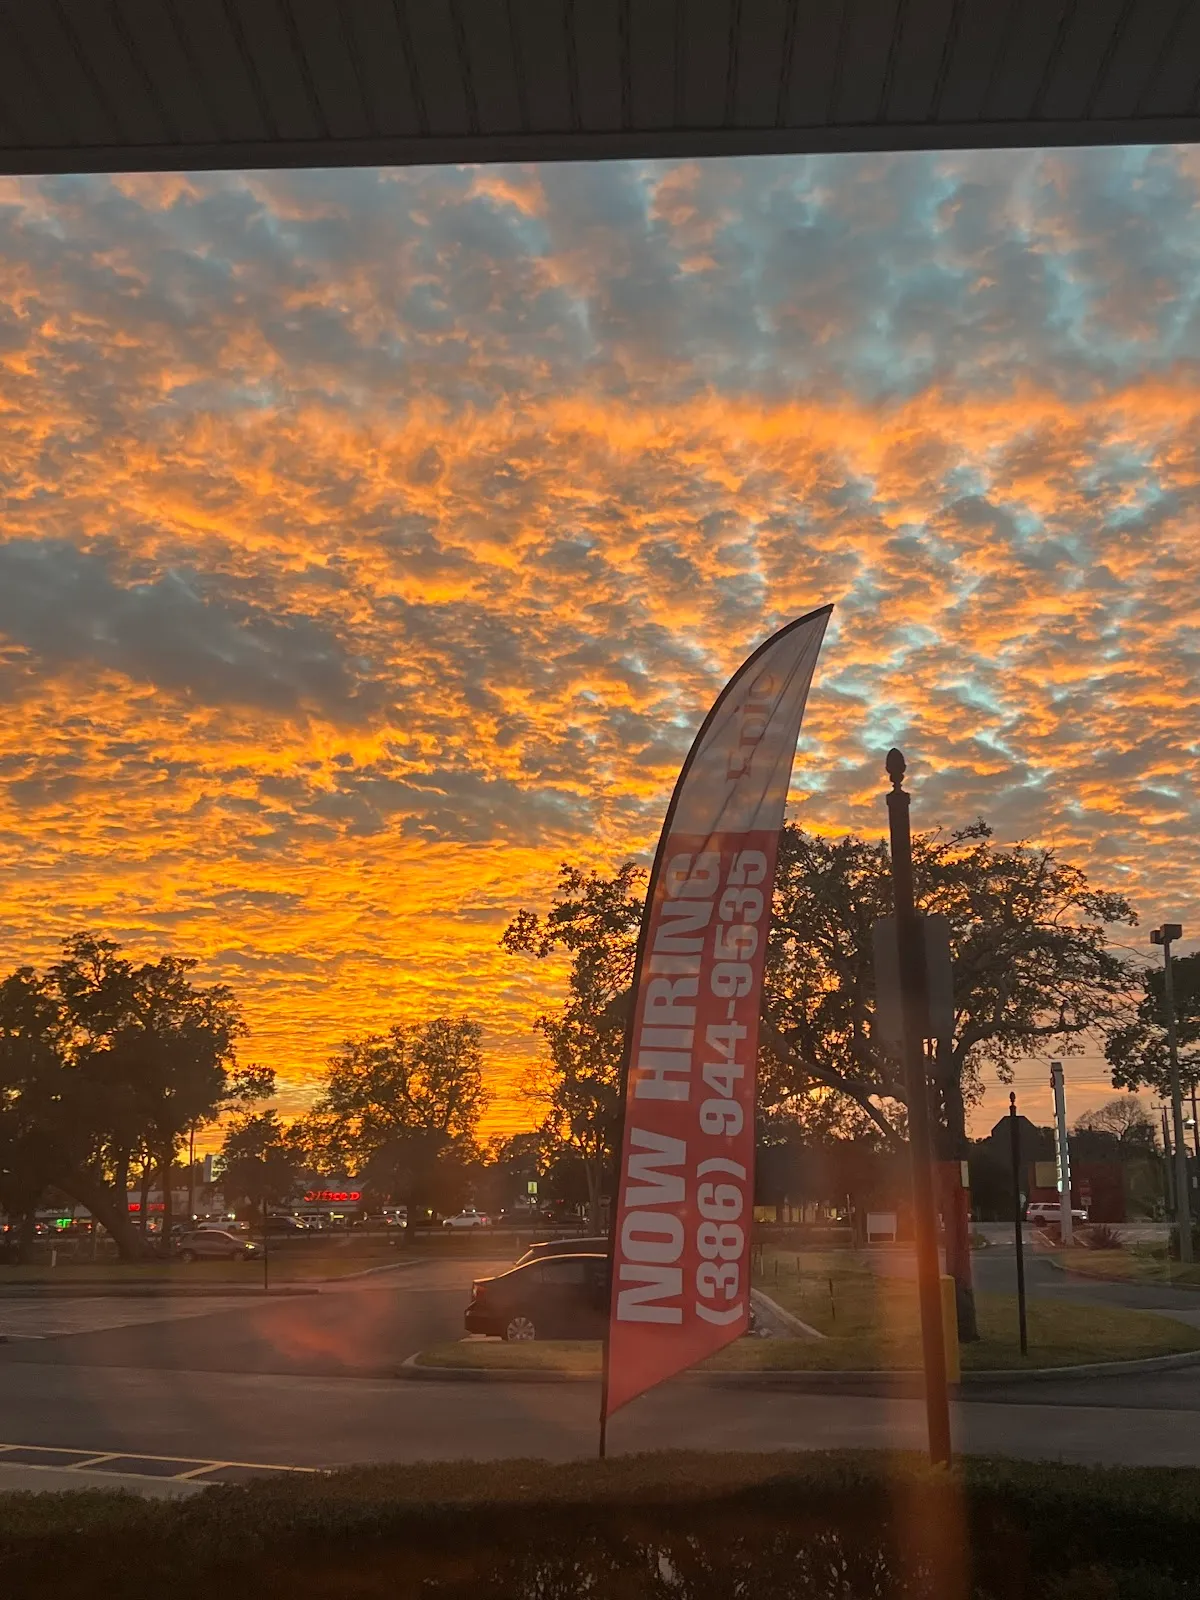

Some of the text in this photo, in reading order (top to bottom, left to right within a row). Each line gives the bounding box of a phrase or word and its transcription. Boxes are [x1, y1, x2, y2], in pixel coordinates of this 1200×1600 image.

[616, 853, 720, 1324] NOW HIRING
[695, 850, 767, 1326] (386) 944-9535
